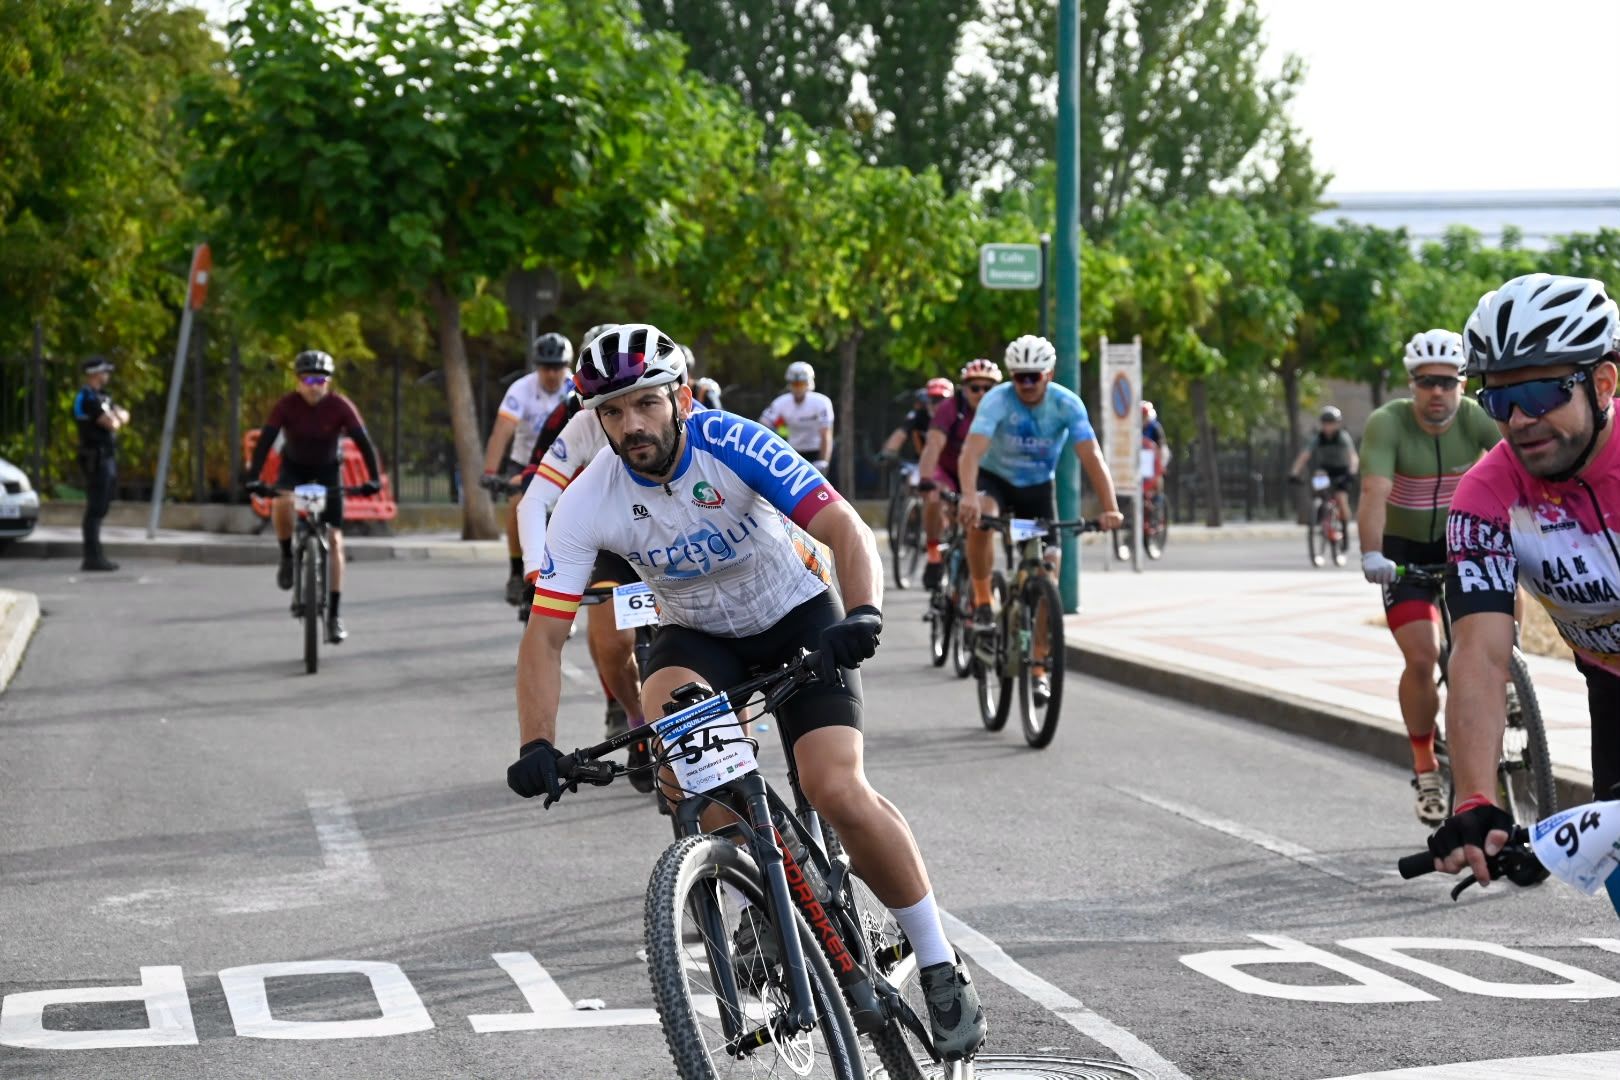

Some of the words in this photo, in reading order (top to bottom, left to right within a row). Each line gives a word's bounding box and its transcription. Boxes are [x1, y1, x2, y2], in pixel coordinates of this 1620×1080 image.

[626, 512, 758, 567] arregui
[1573, 555, 1589, 574] DE
[628, 593, 656, 610] 63
[1555, 577, 1619, 603] PALMA
[678, 729, 725, 765] 54
[1555, 811, 1601, 858] 94
